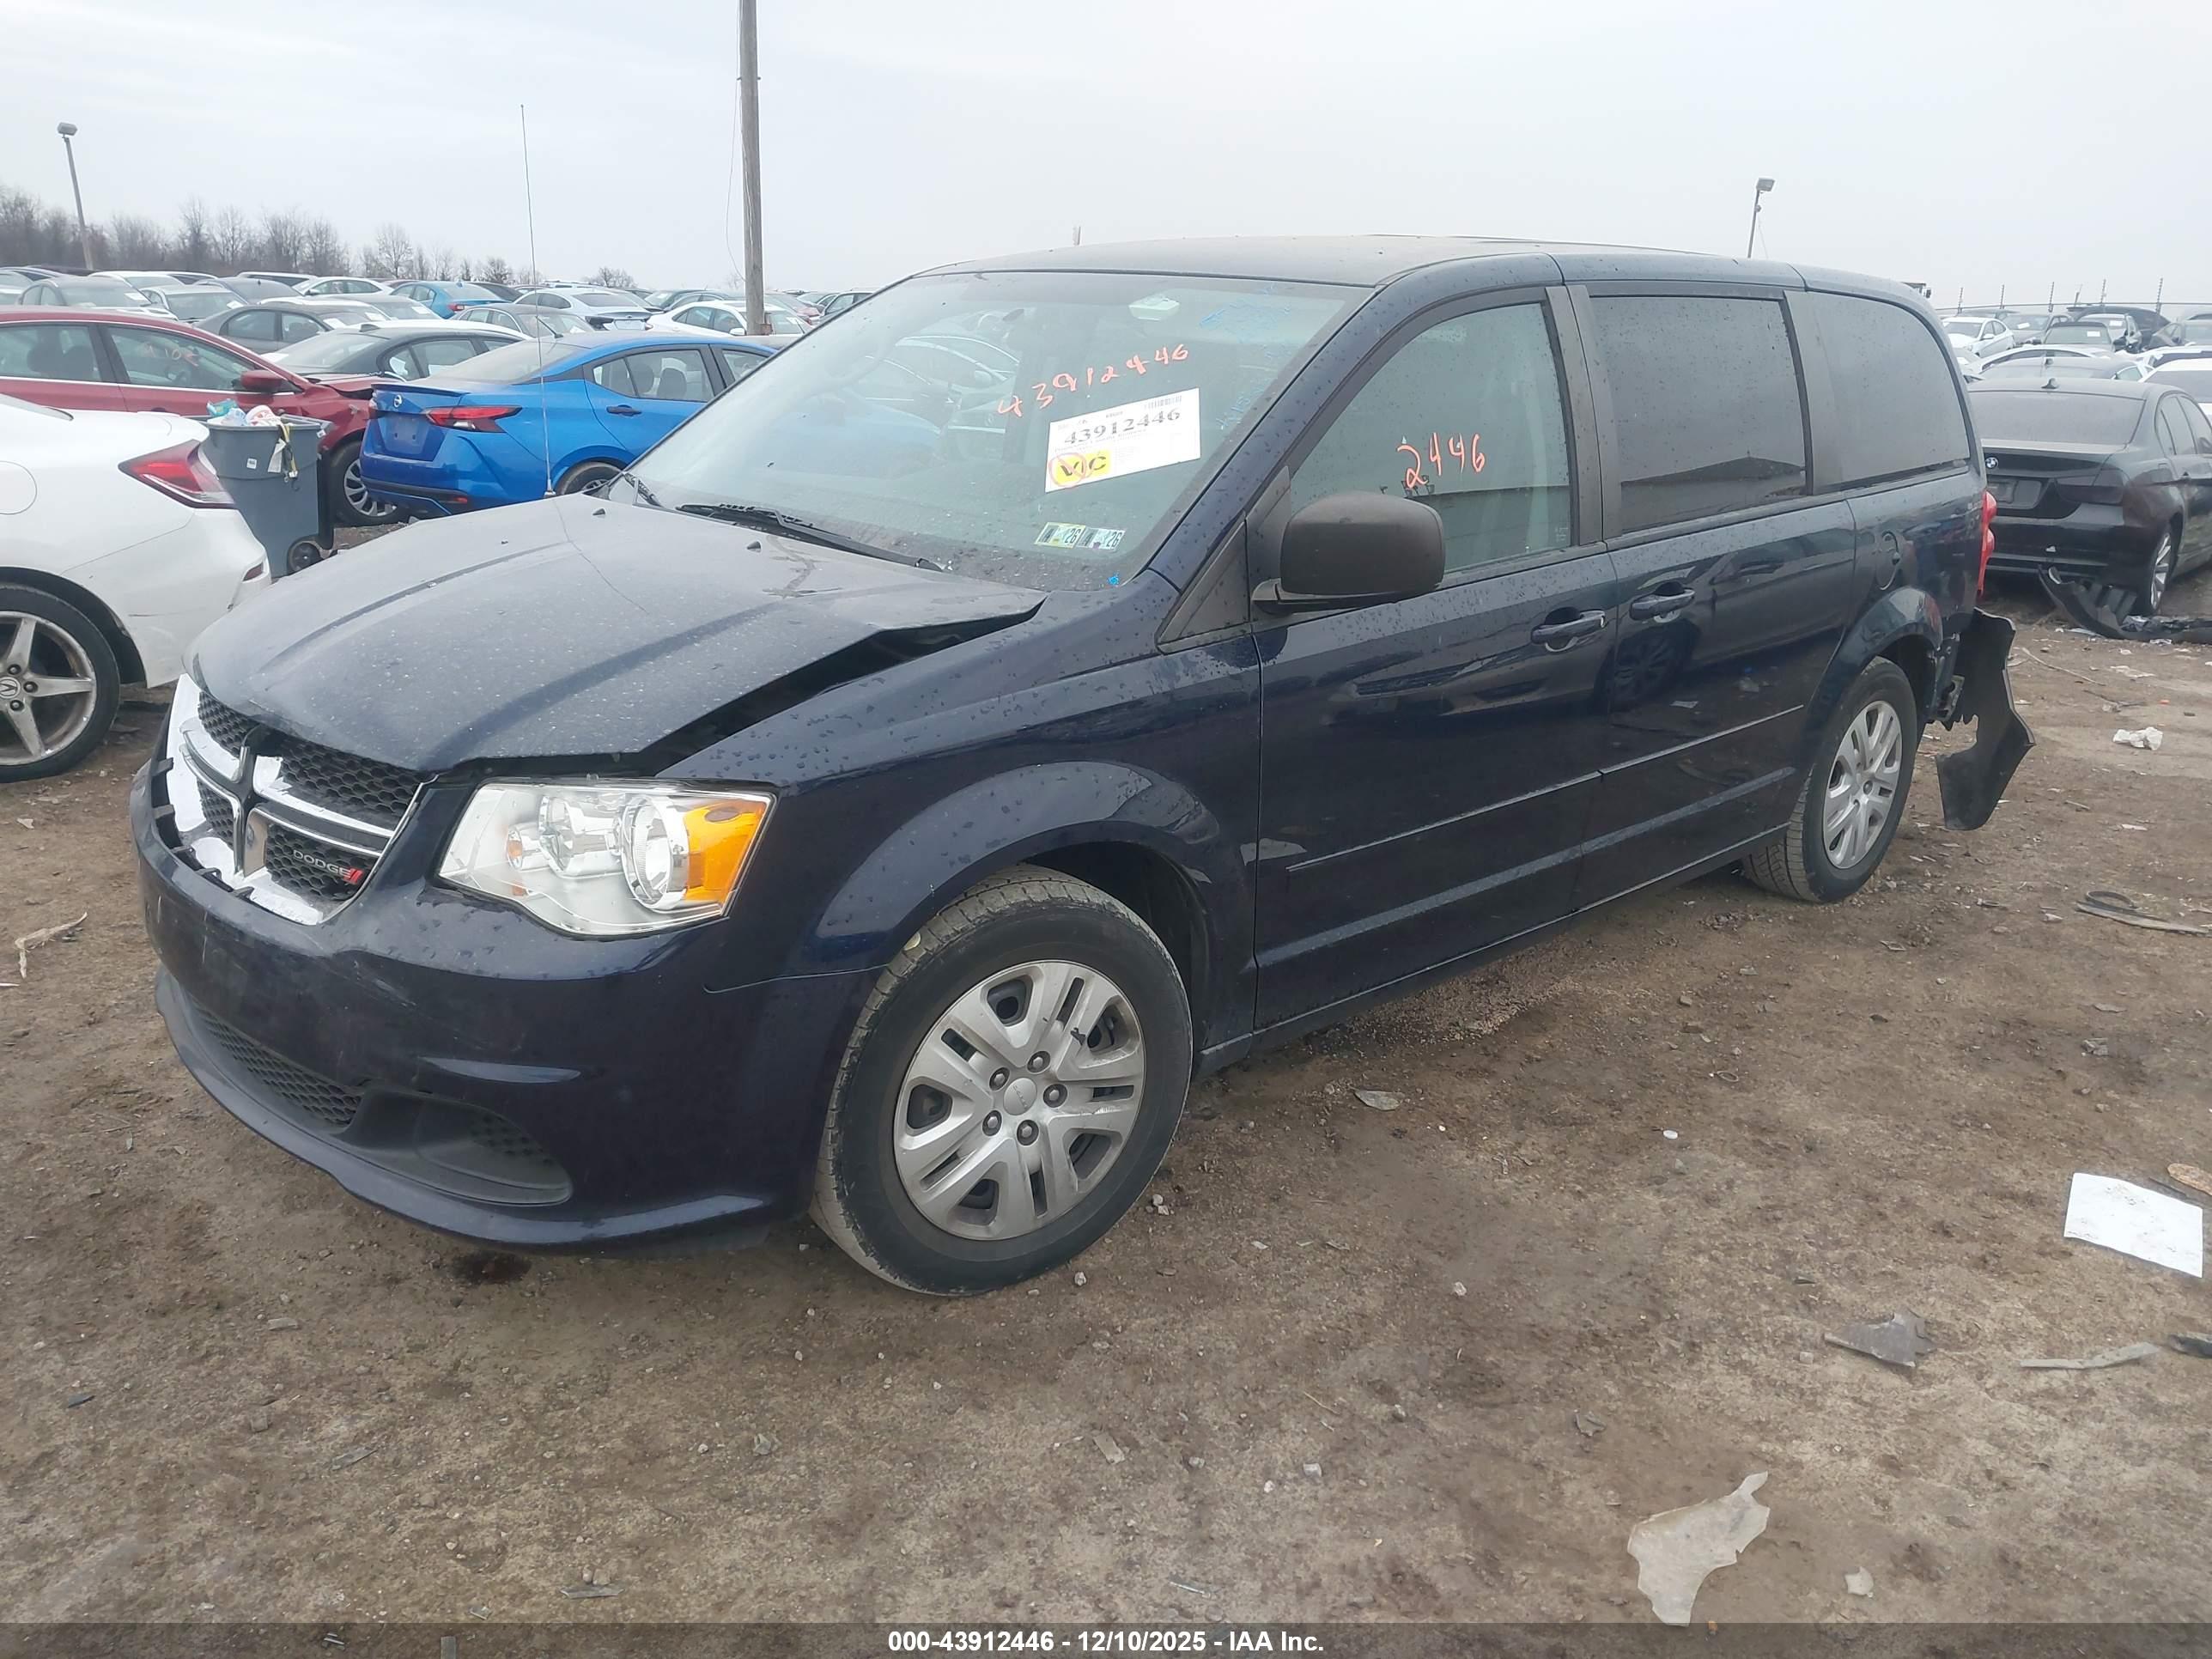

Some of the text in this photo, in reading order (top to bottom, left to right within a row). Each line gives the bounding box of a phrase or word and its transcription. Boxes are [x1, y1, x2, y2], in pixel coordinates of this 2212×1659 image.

[997, 343, 1188, 417] 43912446
[1064, 408, 1181, 445] 43912446
[1396, 432, 1486, 489] 2446
[293, 849, 351, 878] DODGE
